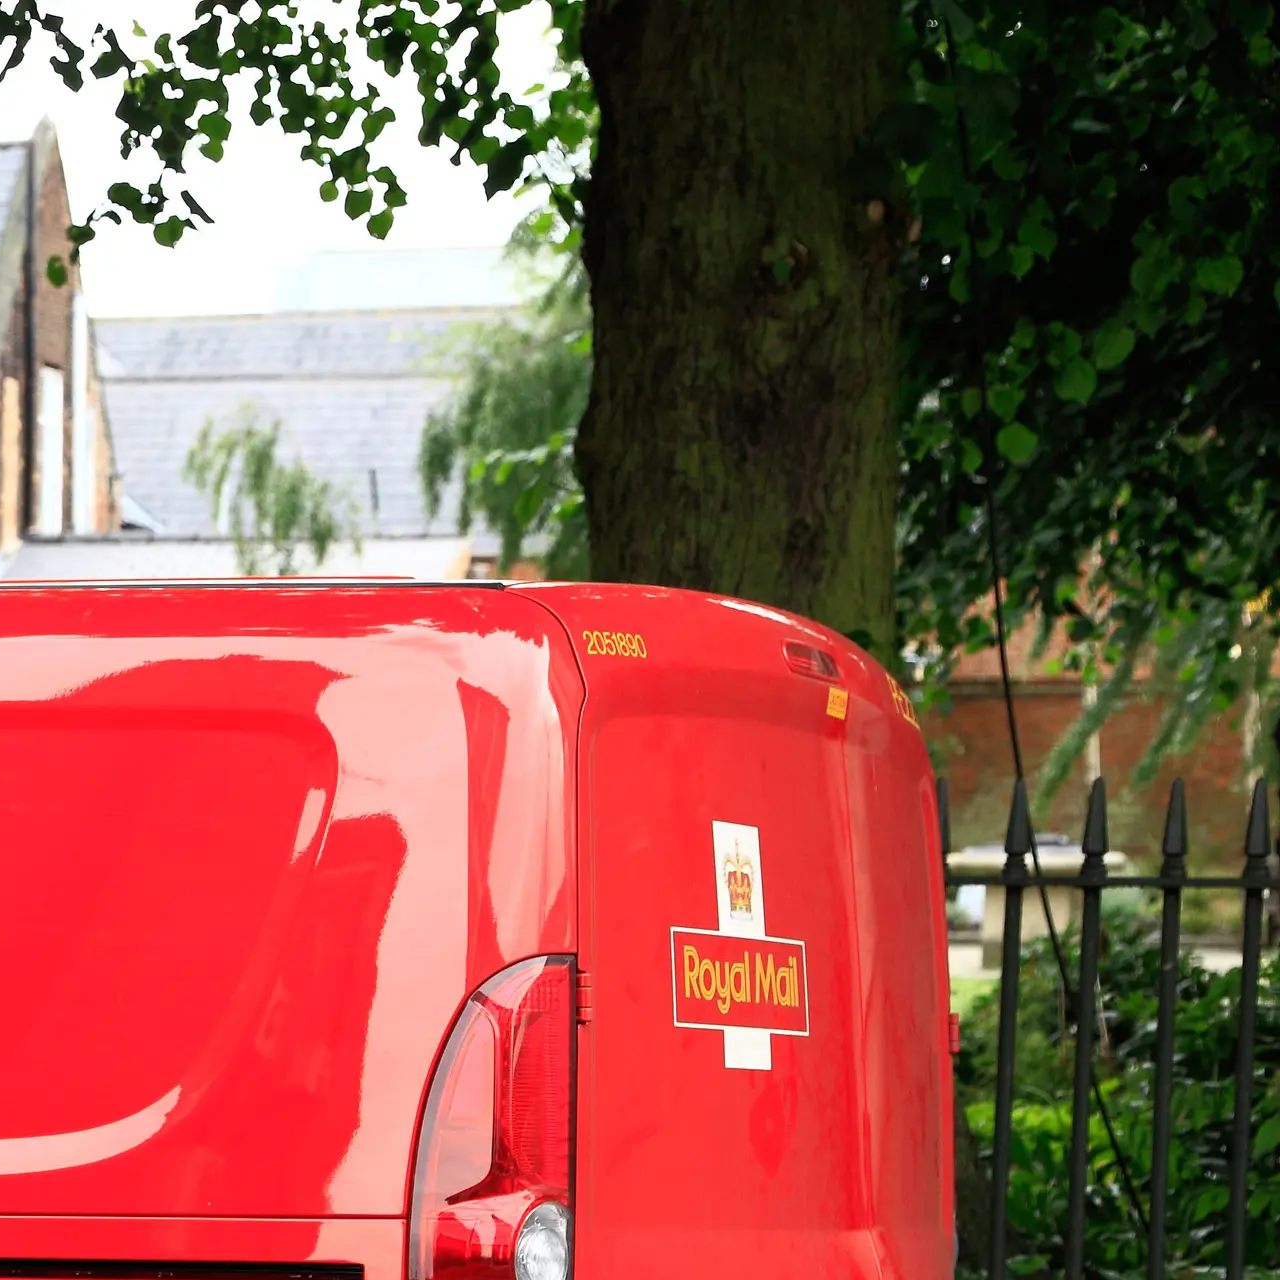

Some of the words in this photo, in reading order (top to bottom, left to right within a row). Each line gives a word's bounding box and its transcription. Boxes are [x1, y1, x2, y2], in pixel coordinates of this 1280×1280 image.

[583, 630, 647, 659] 2051890
[683, 945, 752, 1015] Royal
[755, 952, 800, 1008] Mail
